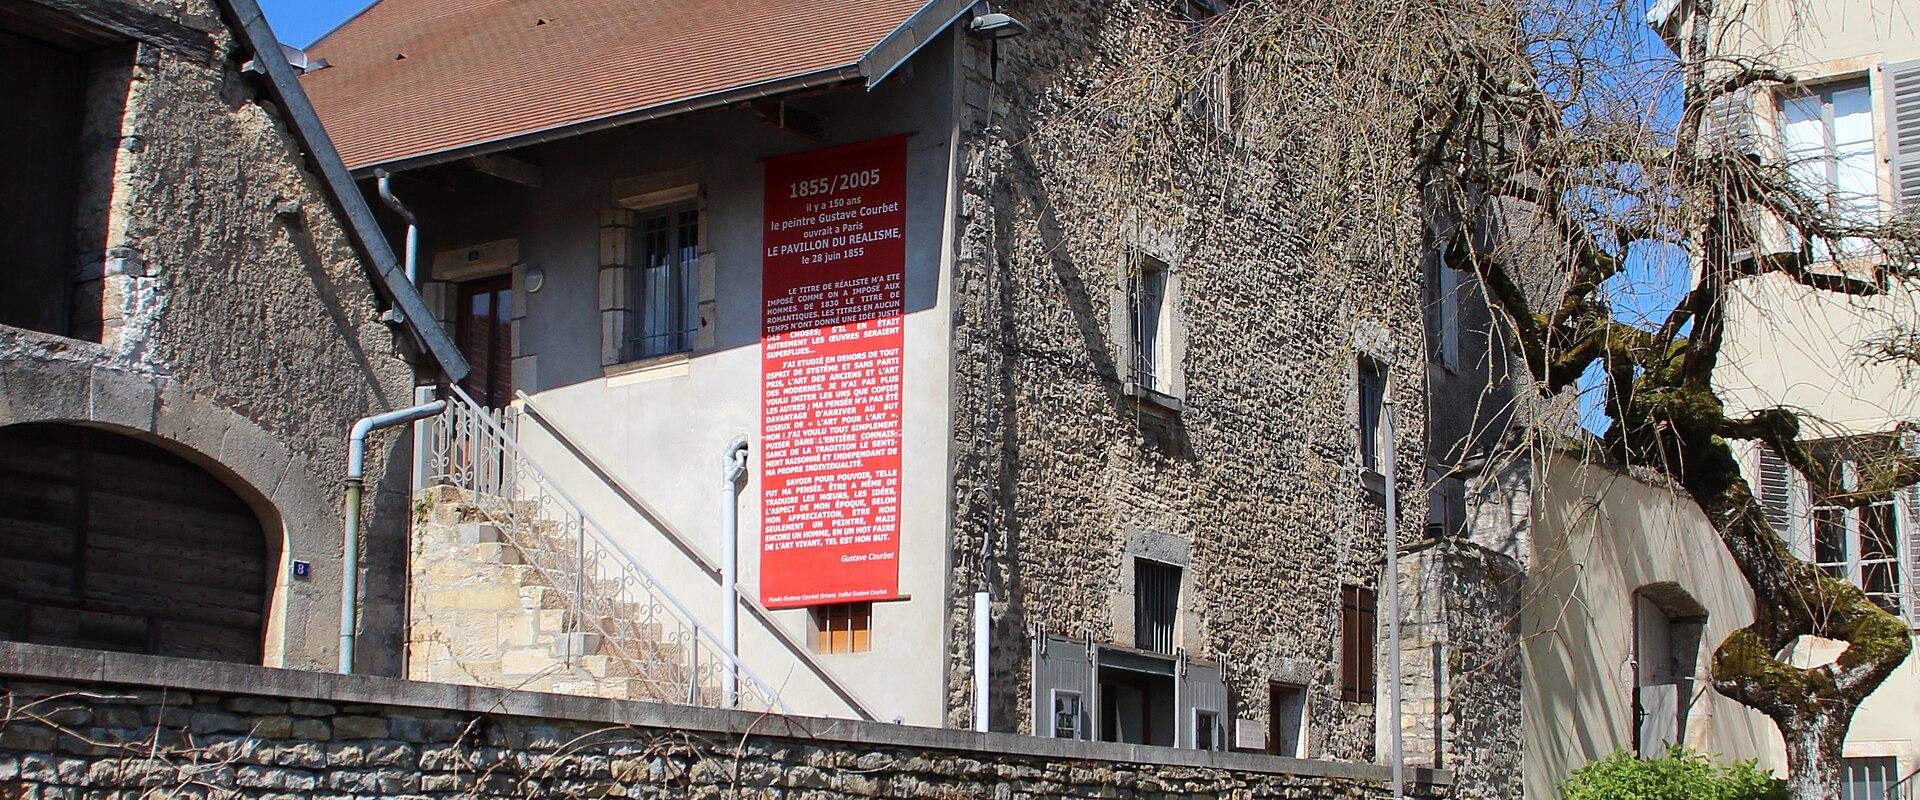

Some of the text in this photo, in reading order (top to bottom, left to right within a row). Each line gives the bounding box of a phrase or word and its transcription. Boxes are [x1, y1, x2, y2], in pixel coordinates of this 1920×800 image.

[790, 168, 880, 198] 1855/2005
[806, 203, 811, 212] il
[829, 198, 844, 208] 150
[847, 196, 861, 205] ans
[772, 202, 898, 230] le peintre Gustave Courbet
[804, 226, 832, 238] ouvrait
[843, 221, 863, 232] Paris
[768, 228, 900, 256] LE PAVILLON DU REALISME,
[802, 247, 864, 264] le 28 juin 1855
[800, 284, 820, 292] TITRE
[767, 305, 797, 314] HOMMES
[861, 294, 882, 302] TITRE
[798, 293, 823, 302] COMME
[767, 311, 819, 323] ROMANTIQUES.
[836, 306, 861, 314] TITRES
[875, 301, 900, 309] AUCUN
[767, 324, 789, 332] TEMPS
[791, 320, 812, 329] N'ONT
[878, 310, 899, 318] JUSTE
[842, 551, 893, 562] Gustave Courbet
[298, 564, 304, 574] 8
